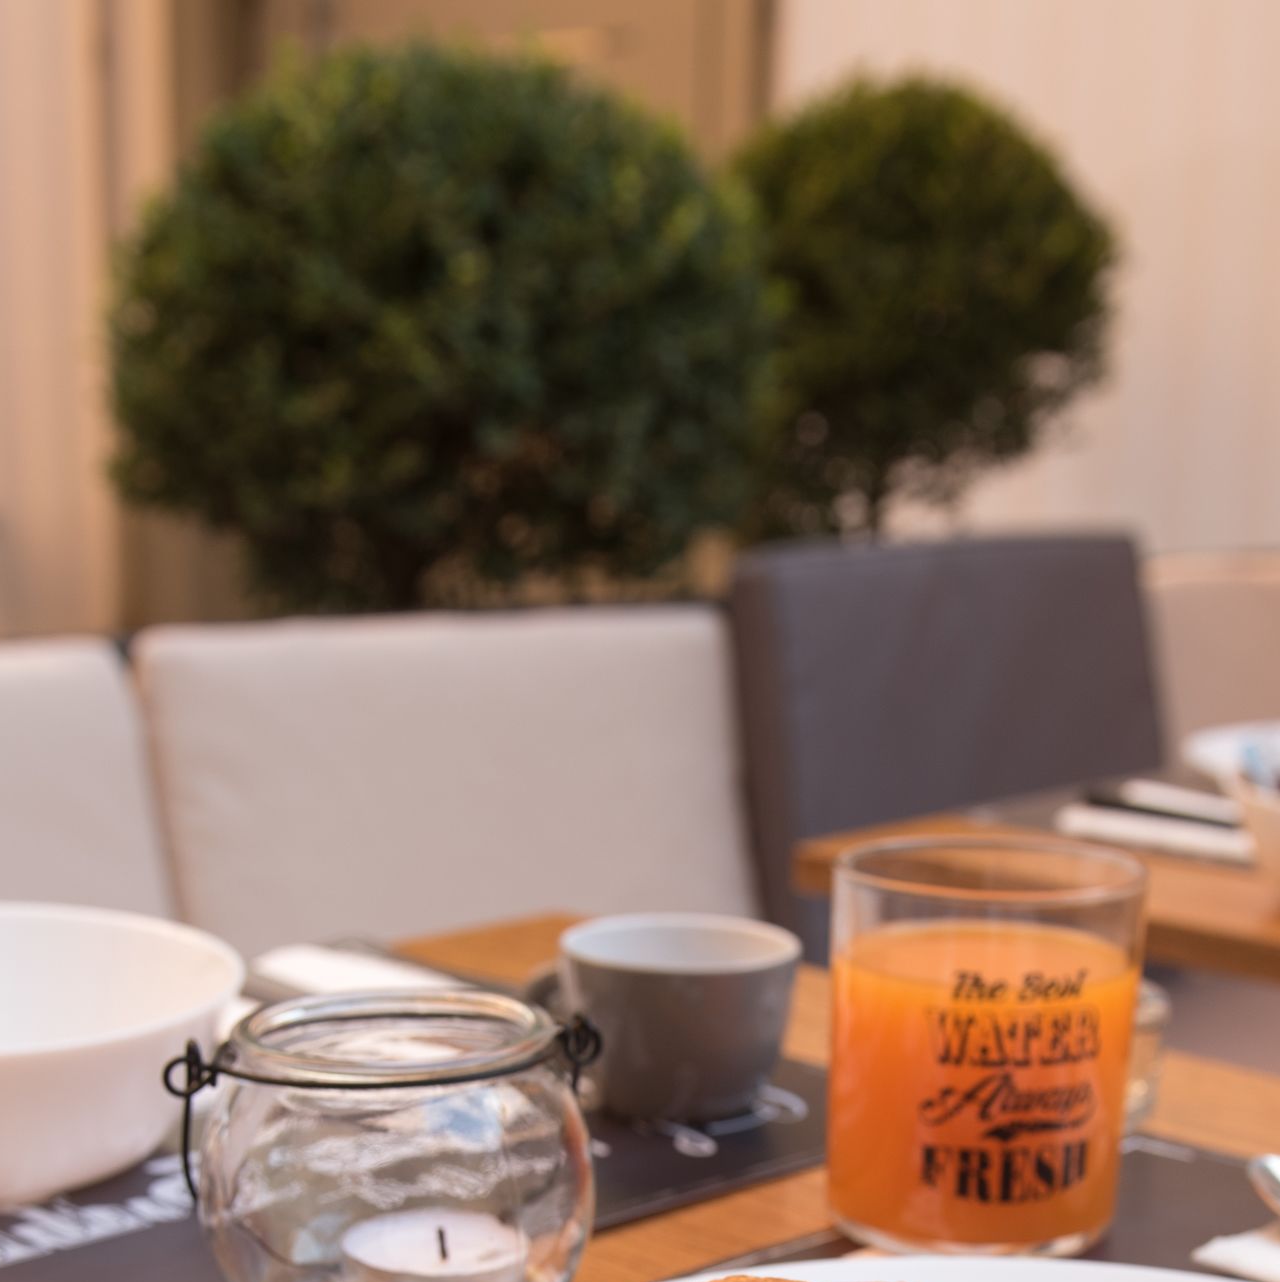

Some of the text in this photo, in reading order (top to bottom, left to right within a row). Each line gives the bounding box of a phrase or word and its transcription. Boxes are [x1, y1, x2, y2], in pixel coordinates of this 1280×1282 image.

[951, 967, 1089, 1001] The Best
[926, 1006, 1102, 1069] WATER
[919, 1071, 1097, 1127] Always
[922, 1141, 1089, 1206] FRESH
